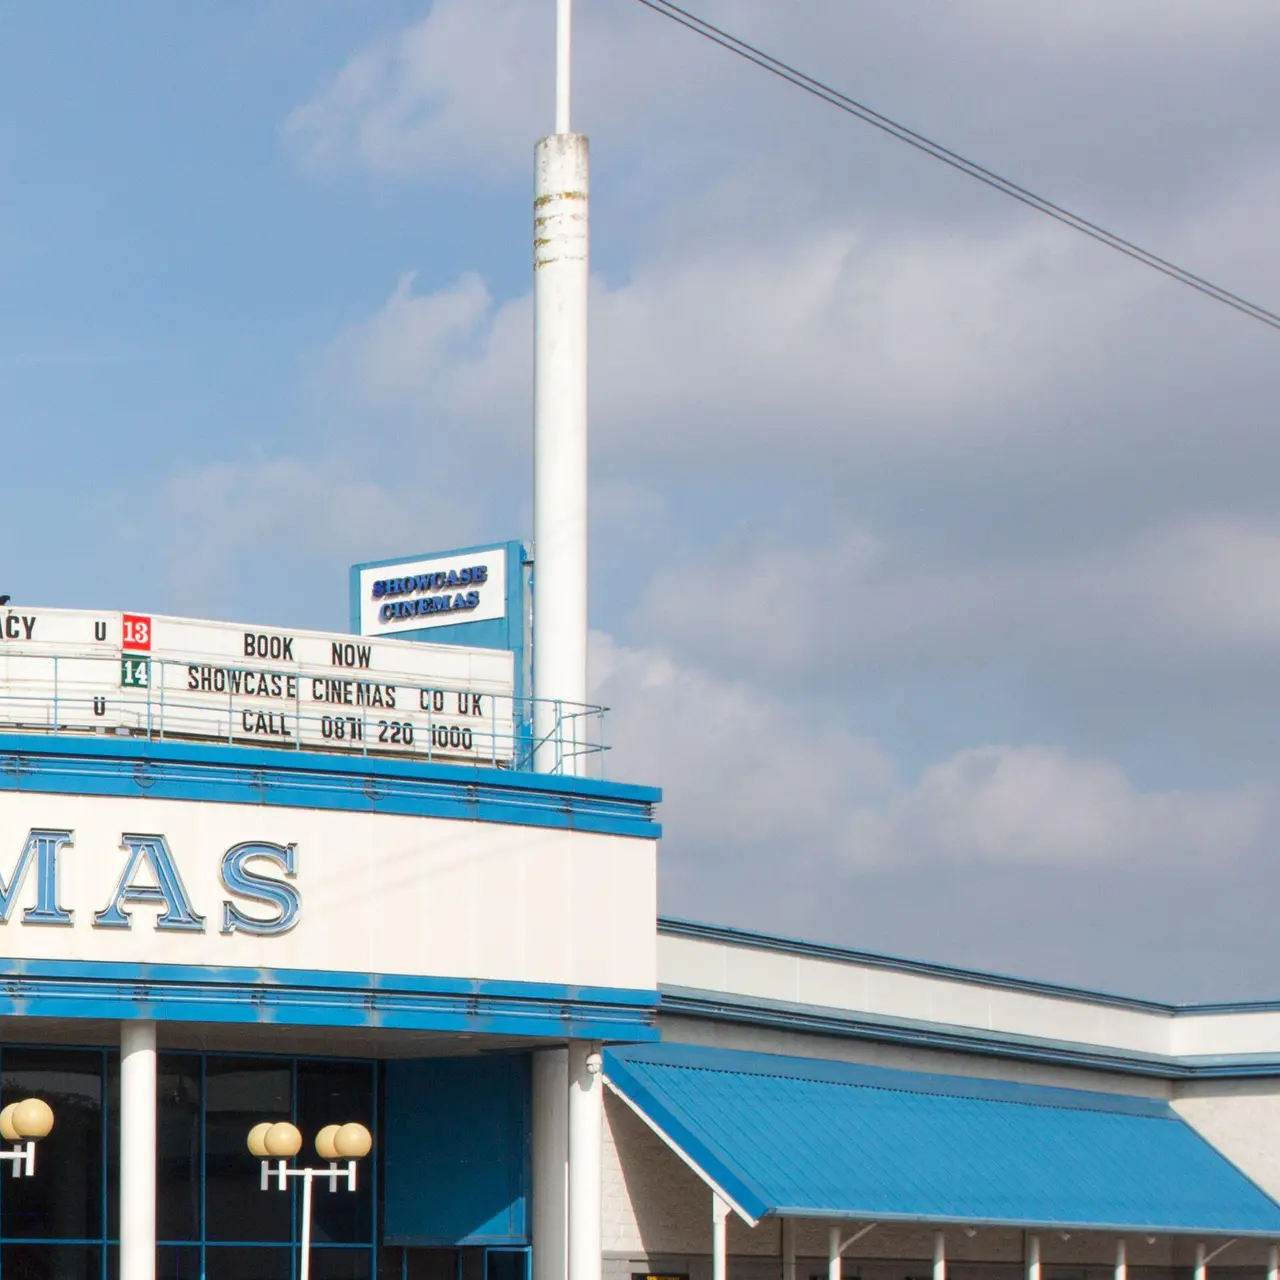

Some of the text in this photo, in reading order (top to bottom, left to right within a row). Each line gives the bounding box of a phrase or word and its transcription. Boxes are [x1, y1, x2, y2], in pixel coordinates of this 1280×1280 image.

[372, 565, 487, 597] SHOWCASE
[381, 591, 479, 620] CINEMAS
[95, 621, 372, 668] U 13 BOOK NOW
[124, 661, 483, 716] 14 SHOWCASE CINEMAS CO UK
[242, 709, 291, 736] CALL
[322, 716, 362, 740] 0871
[378, 721, 413, 745] 220
[431, 724, 473, 750] 1000
